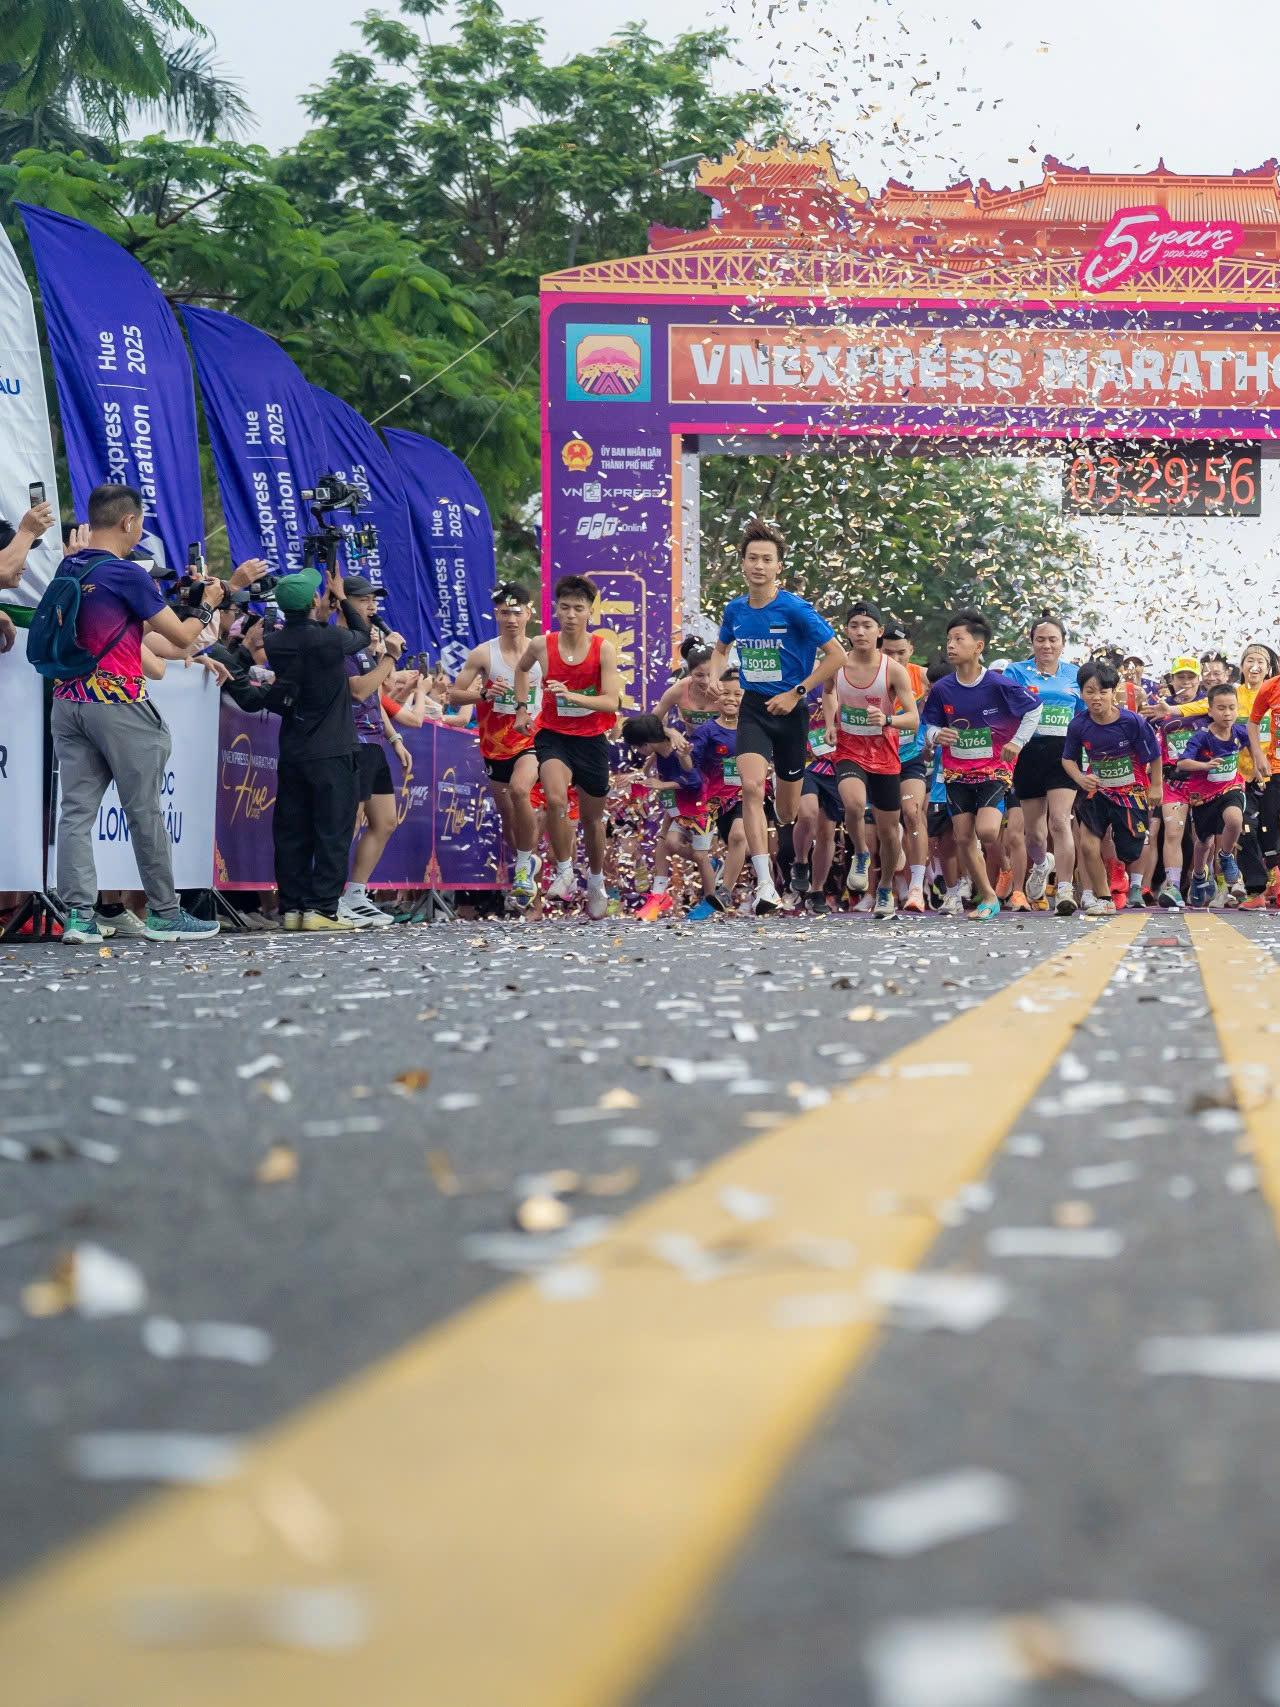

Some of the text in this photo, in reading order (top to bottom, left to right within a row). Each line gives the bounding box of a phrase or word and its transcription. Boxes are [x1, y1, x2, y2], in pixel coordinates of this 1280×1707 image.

[1085, 214, 1234, 289] 5 years
[1162, 250, 1209, 259] 2020-2025
[98, 330, 115, 371] Hue
[122, 324, 147, 375] 2025
[689, 343, 1023, 389] VNEXPRESS
[245, 410, 260, 445] Hue
[265, 403, 287, 446] 2025
[103, 401, 129, 487] Express
[130, 404, 158, 518] Marathon
[611, 447, 627, 457] BAN
[627, 445, 647, 457] NHÂN
[647, 445, 662, 457] DÂN
[601, 458, 625, 470] THÀNH
[1070, 455, 1257, 506] 03:29:56
[252, 471, 281, 574] VnExpress
[277, 471, 304, 571] Marathon
[431, 509, 444, 537] Hue
[449, 503, 464, 538] 2025
[576, 513, 619, 540] FPT
[435, 557, 452, 639] VnExpress
[453, 557, 470, 636] Marathon
[735, 637, 785, 650] ESTONIA
[748, 658, 777, 669] 50128
[504, 694, 532, 703] 503
[958, 736, 987, 747] 51766
[221, 749, 279, 771] VNEXPRESS MARATHON
[1100, 766, 1131, 778] 52324
[98, 806, 130, 842] LON
